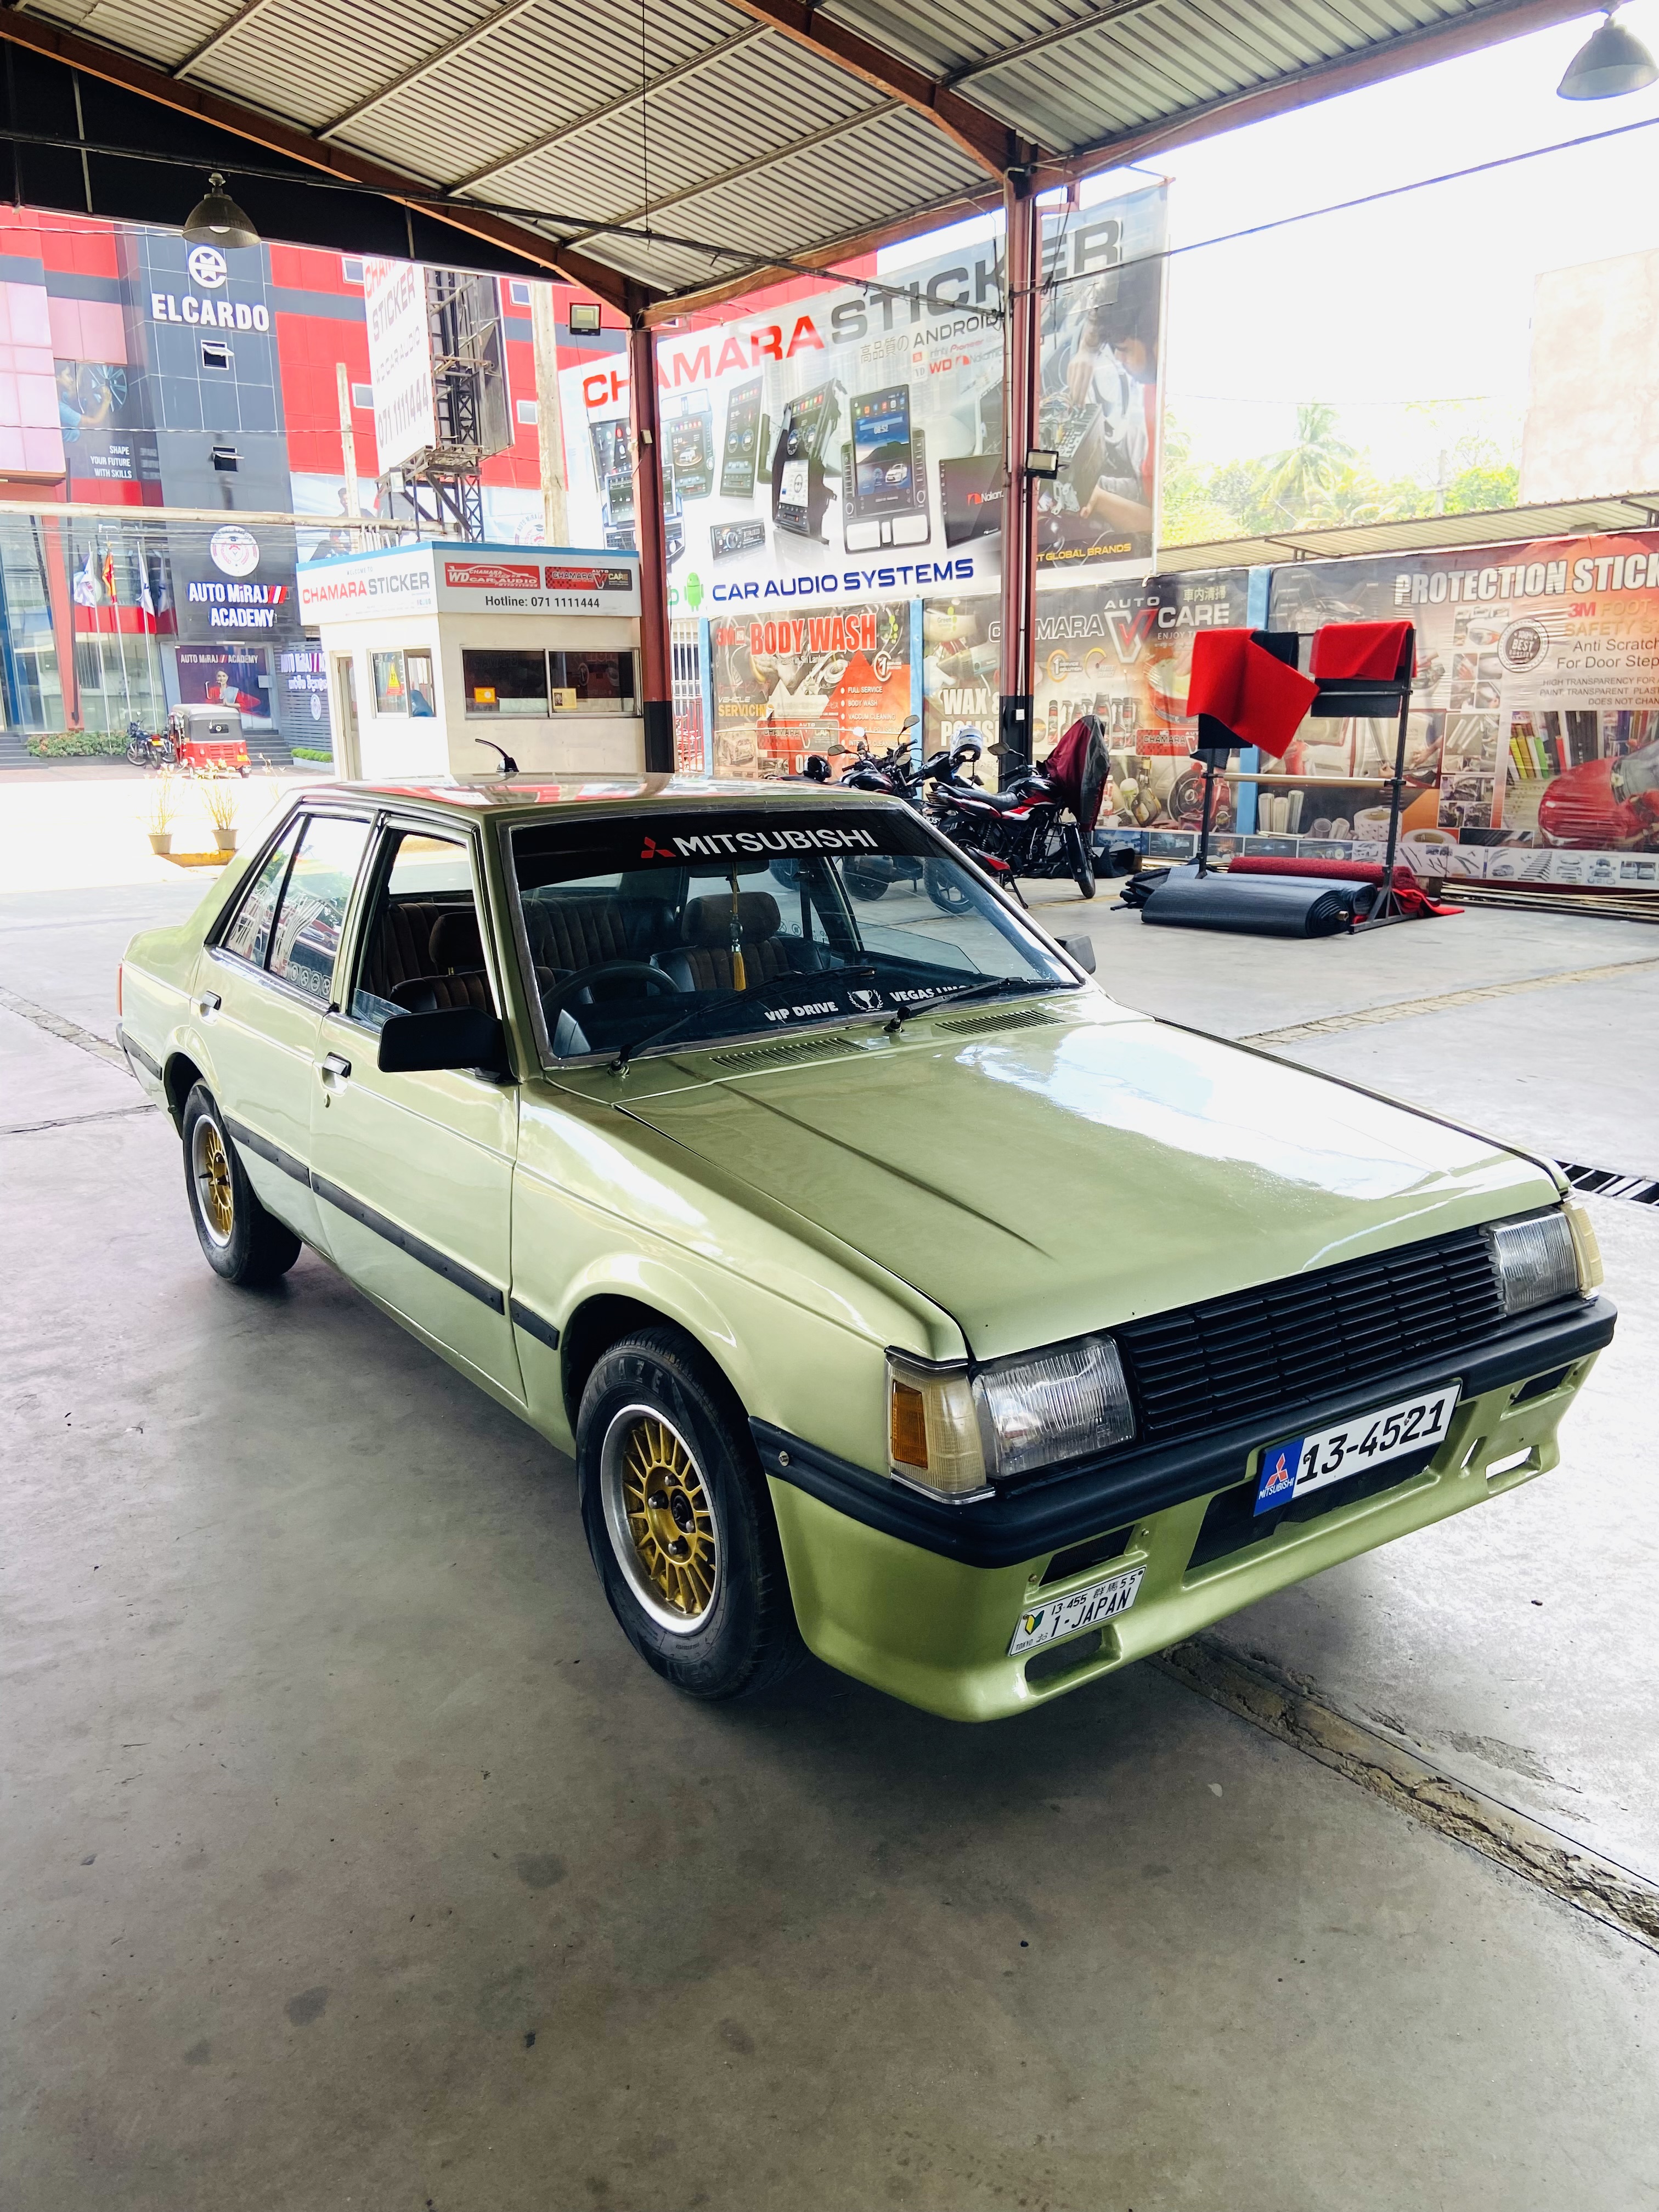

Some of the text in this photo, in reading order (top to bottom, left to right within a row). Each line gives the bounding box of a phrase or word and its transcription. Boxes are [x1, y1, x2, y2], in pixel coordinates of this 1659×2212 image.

[151, 292, 270, 332] ELCARDO
[372, 264, 415, 343] STICKER
[860, 335, 909, 364] 高品質の
[583, 315, 825, 408] CHMARA
[929, 358, 952, 375] WD
[109, 445, 130, 455] SHAPE
[90, 455, 131, 467] YOUR FUTURE
[94, 467, 132, 479] WITH SKILLS
[1045, 549, 1086, 561] GLOBAL
[1087, 543, 1132, 557] BRANDS
[448, 572, 470, 583] WD
[552, 571, 629, 581] CHAMARA CARE
[713, 557, 974, 602] CAR AUDIO SYSTEMS
[1394, 559, 1568, 606] PROTECTION
[189, 582, 226, 602] AUTO
[302, 571, 430, 605] CHAMARA STICKER
[1183, 585, 1227, 603] 車内清掃
[486, 596, 600, 608] Hotline: 071 1111444
[1104, 596, 1161, 610] AUTO
[1567, 601, 1596, 618] 3M
[210, 607, 275, 628] ACADEMY
[1157, 602, 1231, 629] CARE
[749, 619, 805, 656] BODY
[808, 613, 878, 653] WASH
[1157, 631, 1185, 640] ENJOY
[1564, 620, 1636, 637] SAFETY
[1512, 638, 1535, 653] BEST
[1572, 640, 1601, 652] Anti
[180, 654, 198, 664] AUTO
[228, 654, 259, 664] ACADEMY
[1556, 657, 1582, 669] For
[1585, 656, 1621, 669] Door
[1566, 676, 1634, 686] TRANSPARENCY
[1637, 676, 1655, 685] FOR
[1567, 687, 1629, 696] TRANSPARENT
[943, 687, 988, 715] WAX
[1615, 697, 1634, 706] NOT
[873, 740, 898, 748] CLEANING
[1143, 735, 1186, 744] CHAMARA
[672, 828, 879, 857] MITSUBISHI
[889, 988, 935, 1002] VEGAS
[764, 1001, 839, 1022] VIP DRIVE
[1296, 1398, 1446, 1486] 13-4521
[1258, 1476, 1295, 1500] MITSUBISHI
[1051, 1593, 1088, 1616] 13-455
[1092, 1580, 1120, 1599] 群馬
[1015, 1639, 1034, 1651] TOKYO
